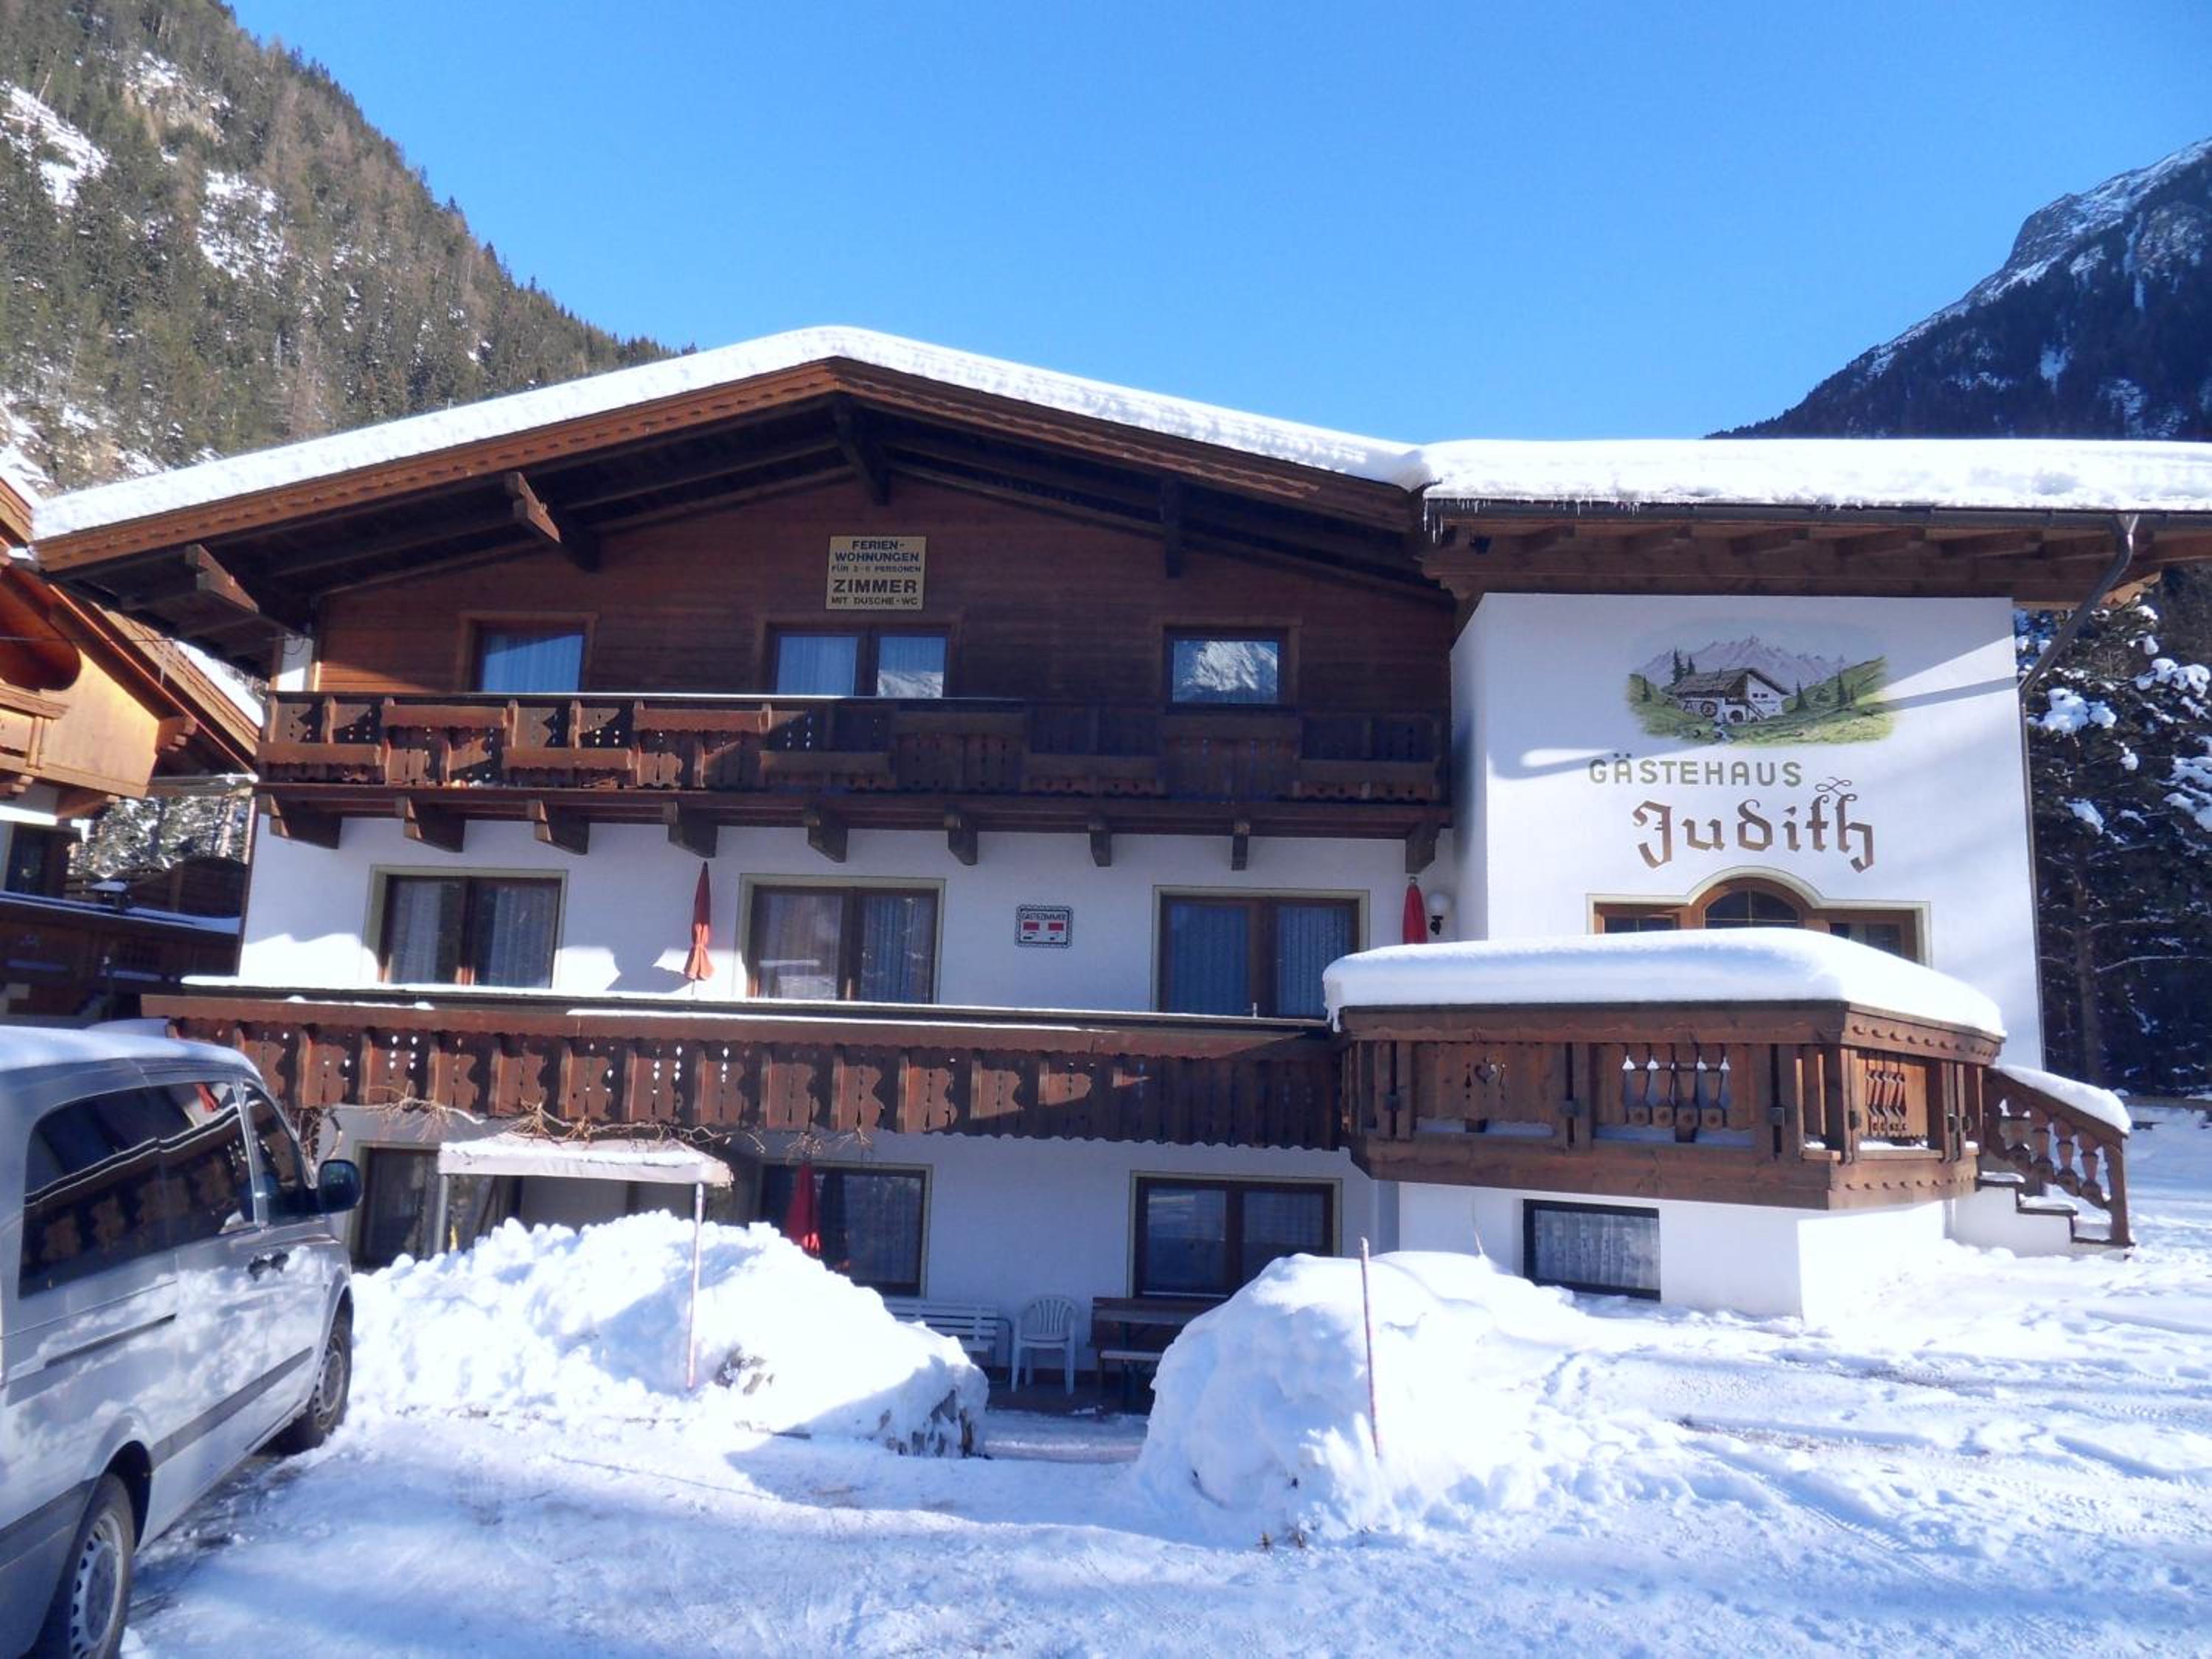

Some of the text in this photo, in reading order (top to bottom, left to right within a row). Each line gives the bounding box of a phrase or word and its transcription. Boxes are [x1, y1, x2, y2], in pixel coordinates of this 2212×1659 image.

[852, 540, 905, 550] FERIEN-
[835, 552, 919, 562] WOHNUNGEN
[874, 565, 921, 573] PERSONEN
[832, 579, 917, 594] ZIMMER
[831, 597, 848, 605] MIT
[1589, 753, 1801, 787] GÄSTEHAUS
[1632, 776, 1874, 873] Judith
